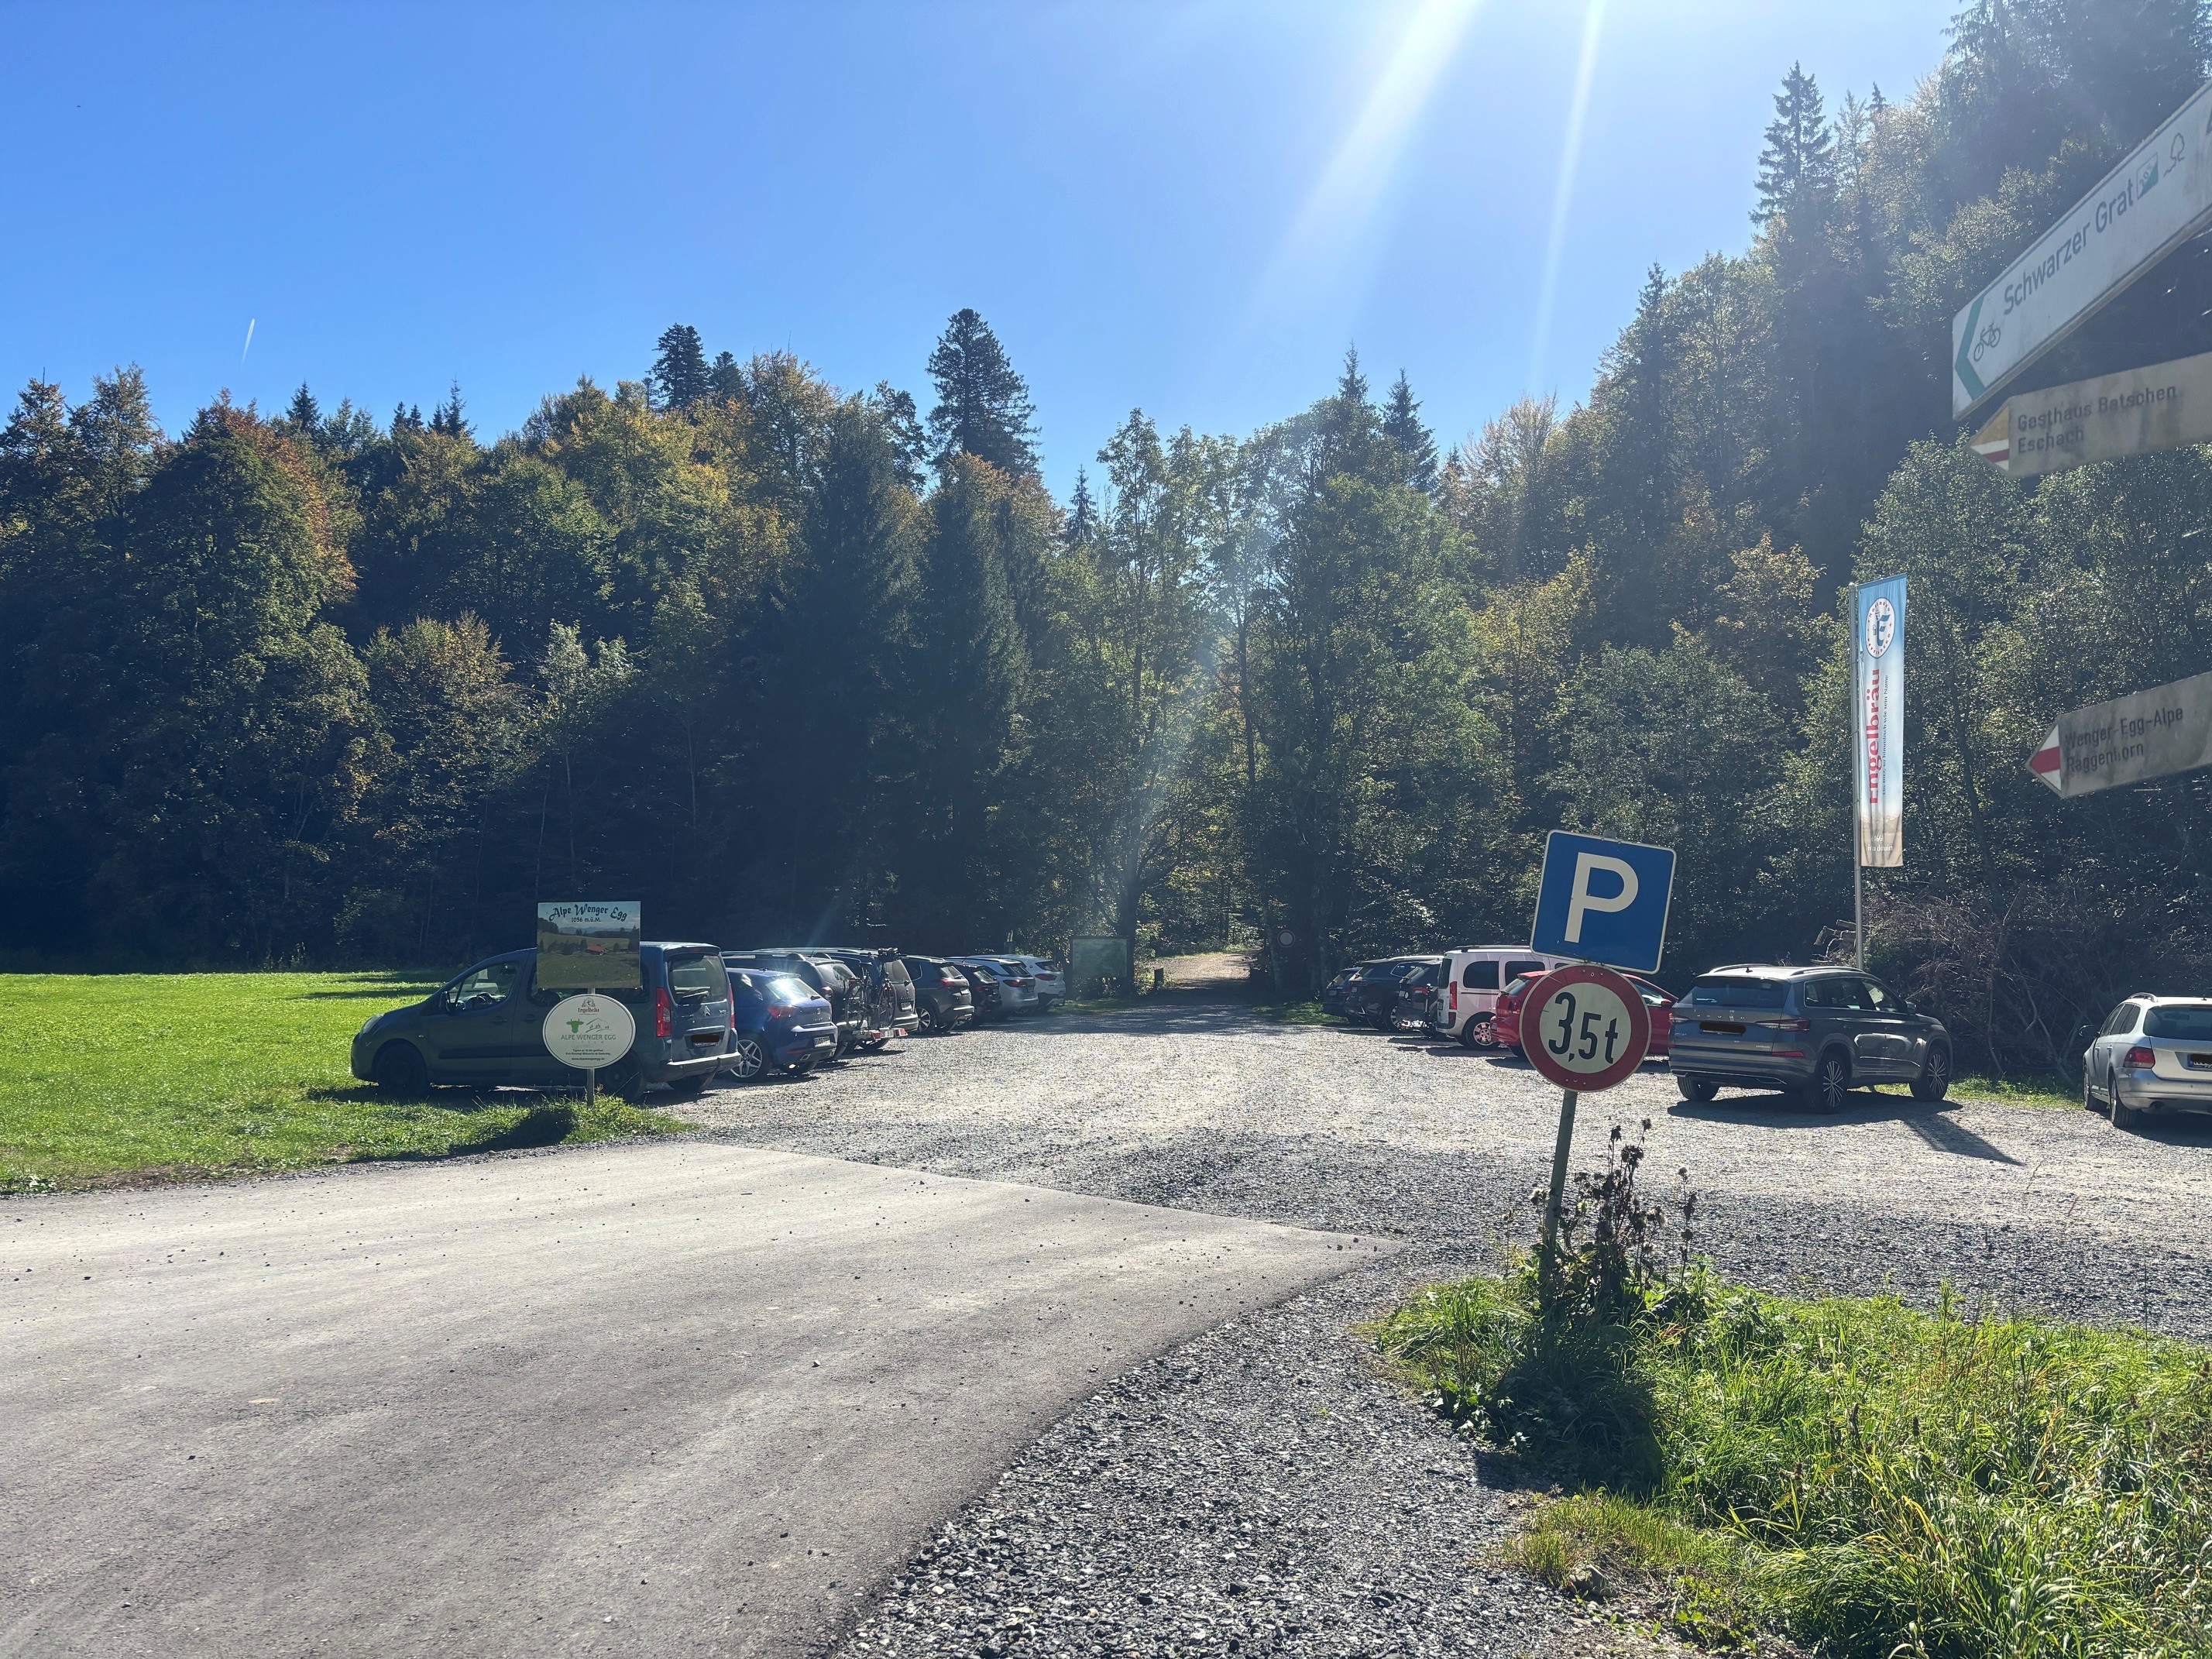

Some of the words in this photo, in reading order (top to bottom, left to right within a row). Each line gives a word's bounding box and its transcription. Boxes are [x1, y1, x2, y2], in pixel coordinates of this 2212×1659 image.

[2003, 222, 2090, 315] Schwarzer
[2096, 178, 2134, 233] Grat
[2018, 404, 2092, 431] Gasthaus
[2098, 386, 2176, 413] Batschen
[2018, 429, 2084, 453] Eschach
[1866, 669, 1882, 804] Engelbräu
[548, 907, 572, 922] Alpe
[574, 903, 608, 916] Wenger
[610, 906, 627, 922] Egg
[1565, 852, 1639, 943] P
